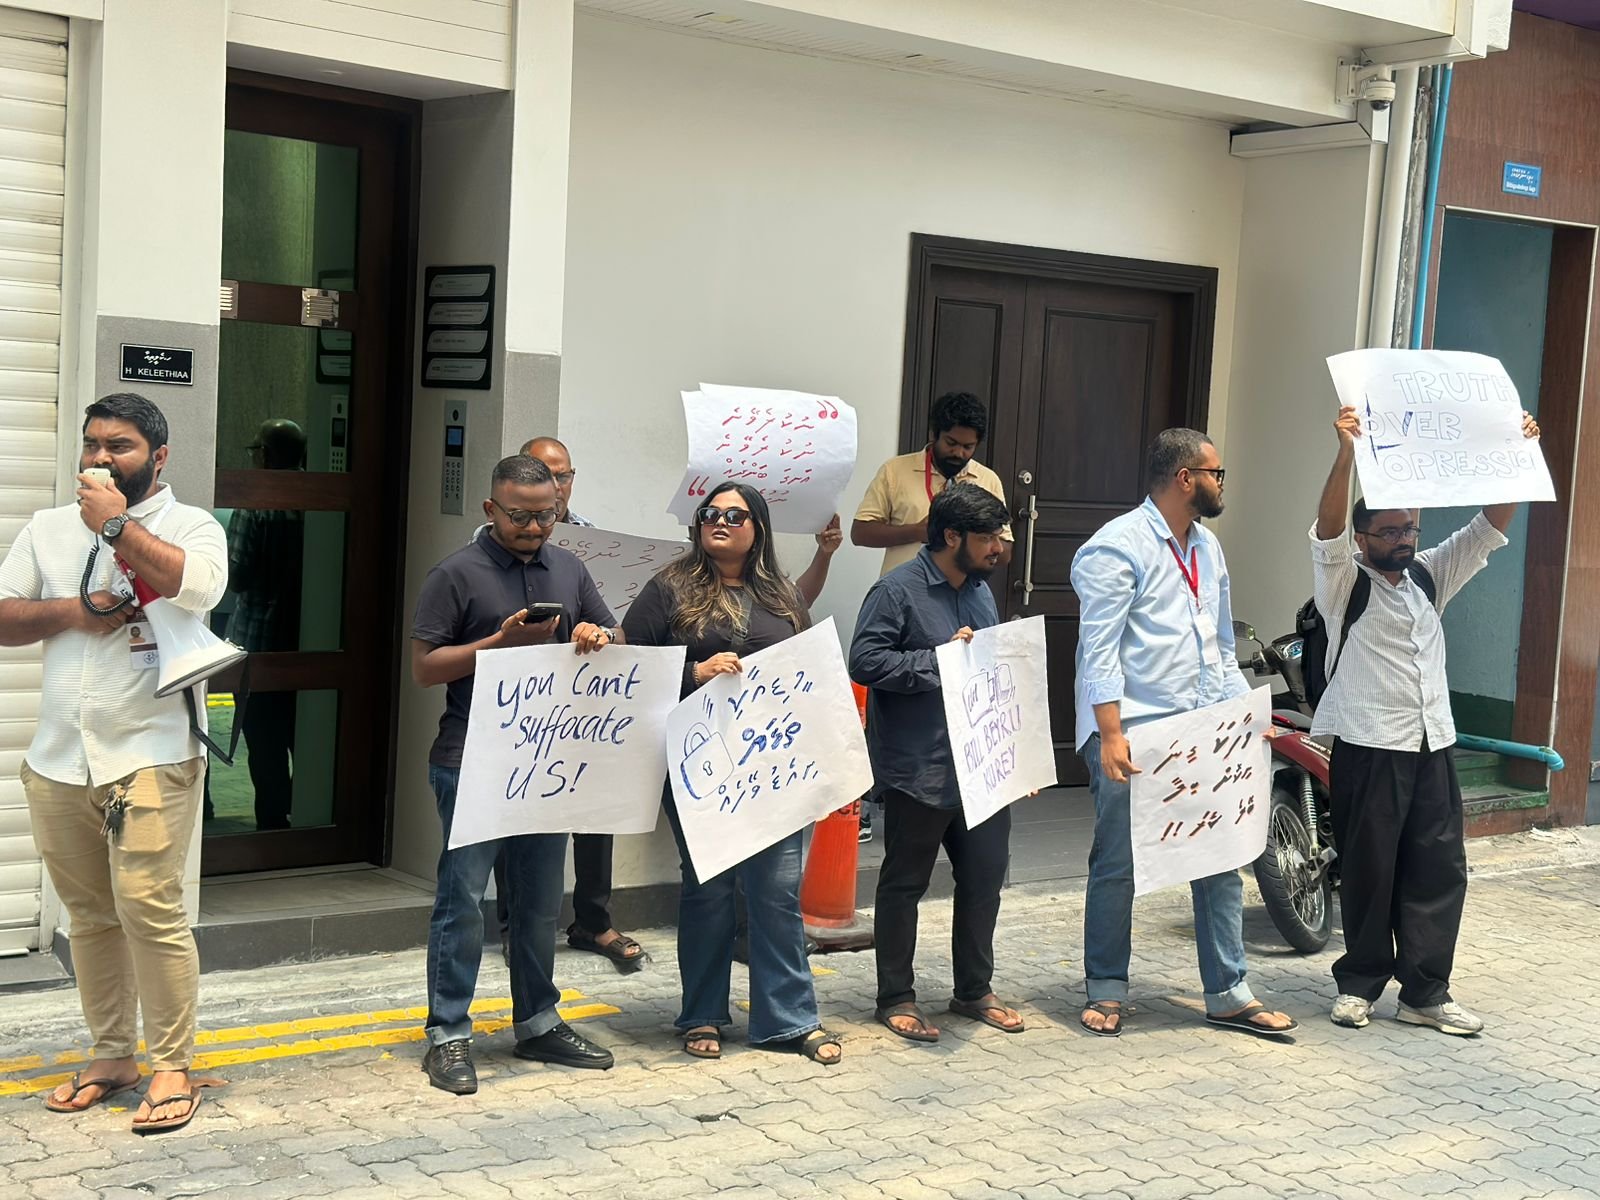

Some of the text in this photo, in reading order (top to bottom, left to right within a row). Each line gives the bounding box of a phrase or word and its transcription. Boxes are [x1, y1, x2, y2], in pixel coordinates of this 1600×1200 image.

[138, 368, 188, 378] KELEETHIAA
[1392, 370, 1518, 404] TRUTH
[1359, 411, 1461, 440] OVER
[514, 704, 634, 760] suffocate
[983, 704, 1022, 754] BEYRU
[983, 742, 1016, 796] KUREY
